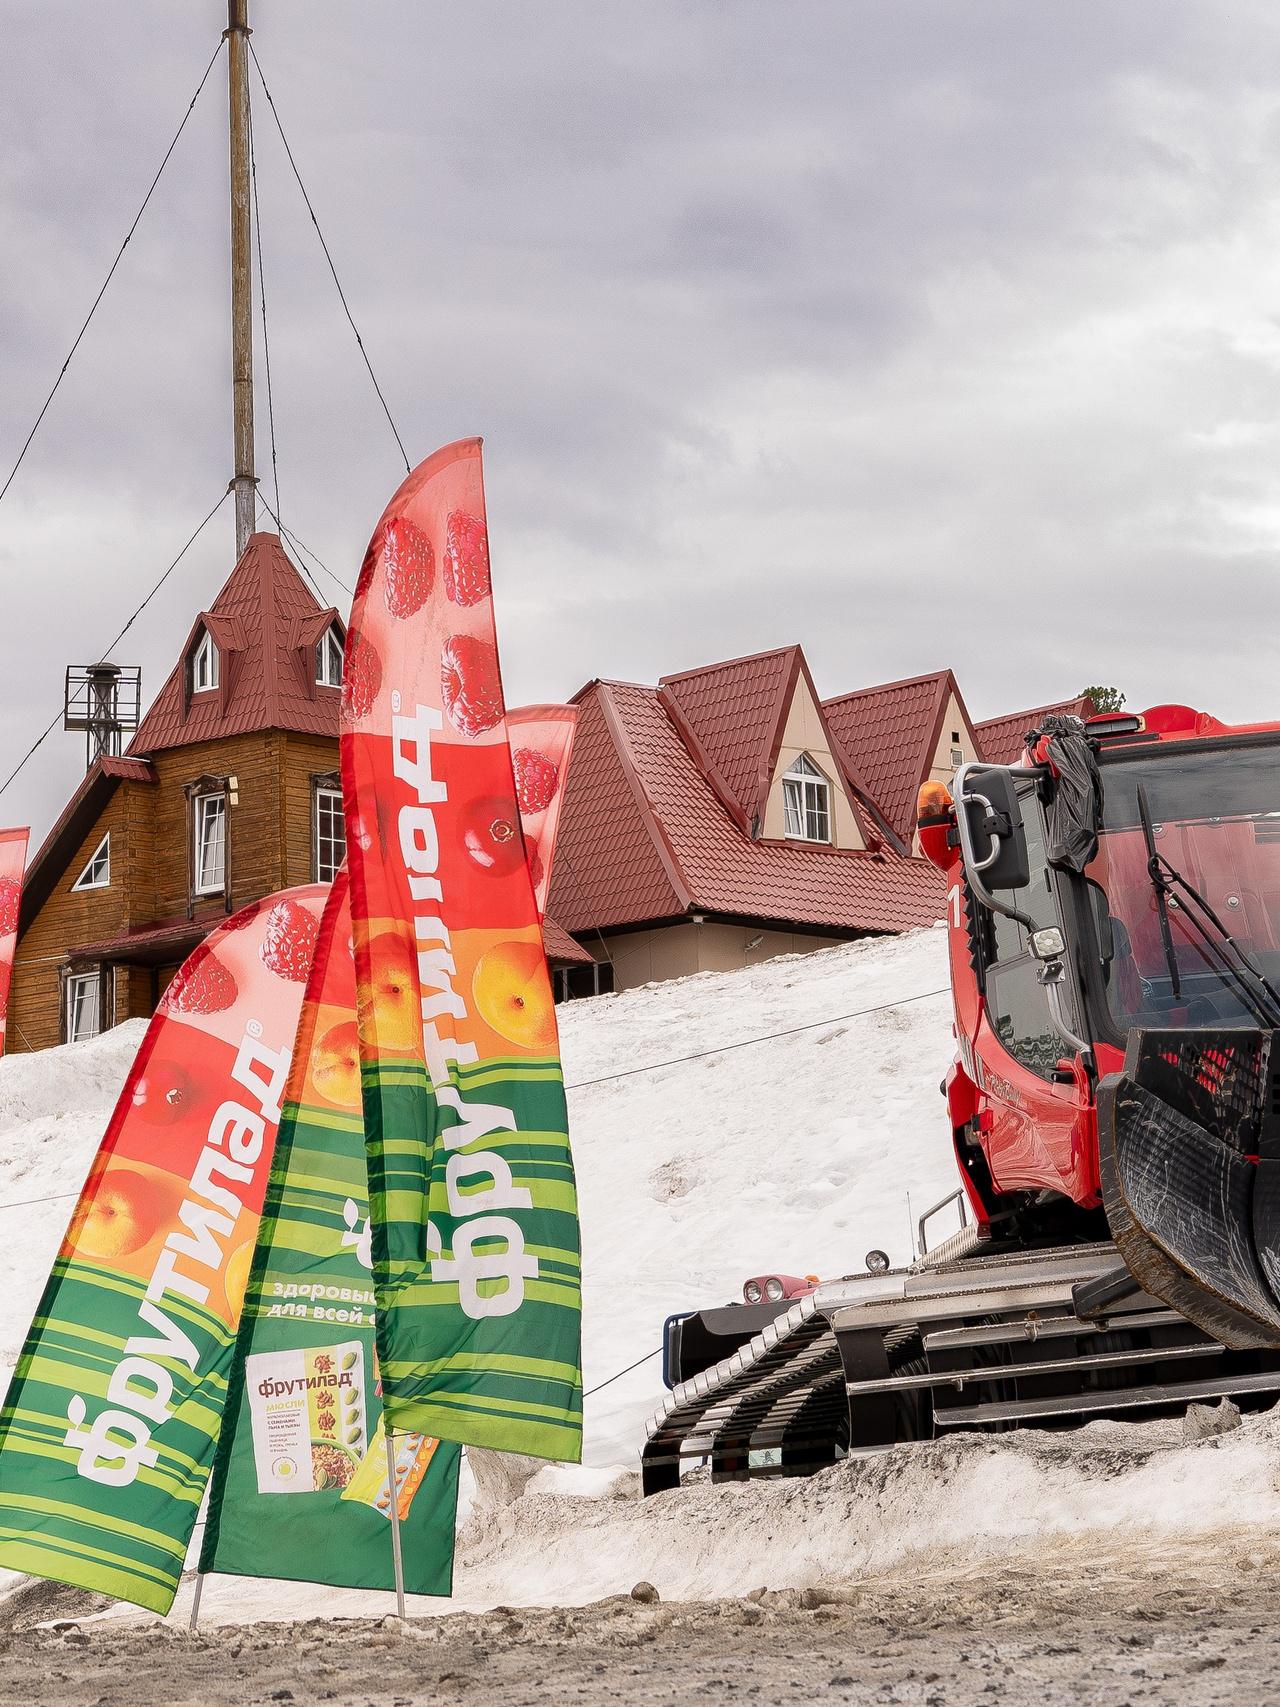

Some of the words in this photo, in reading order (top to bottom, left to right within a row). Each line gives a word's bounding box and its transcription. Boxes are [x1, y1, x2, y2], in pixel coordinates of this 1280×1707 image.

[948, 884, 960, 928] 1
[267, 1303, 308, 1317] для
[314, 1306, 363, 1325] всей
[258, 1372, 352, 1399] фрутилад
[266, 1399, 306, 1412] МЮСЛИ
